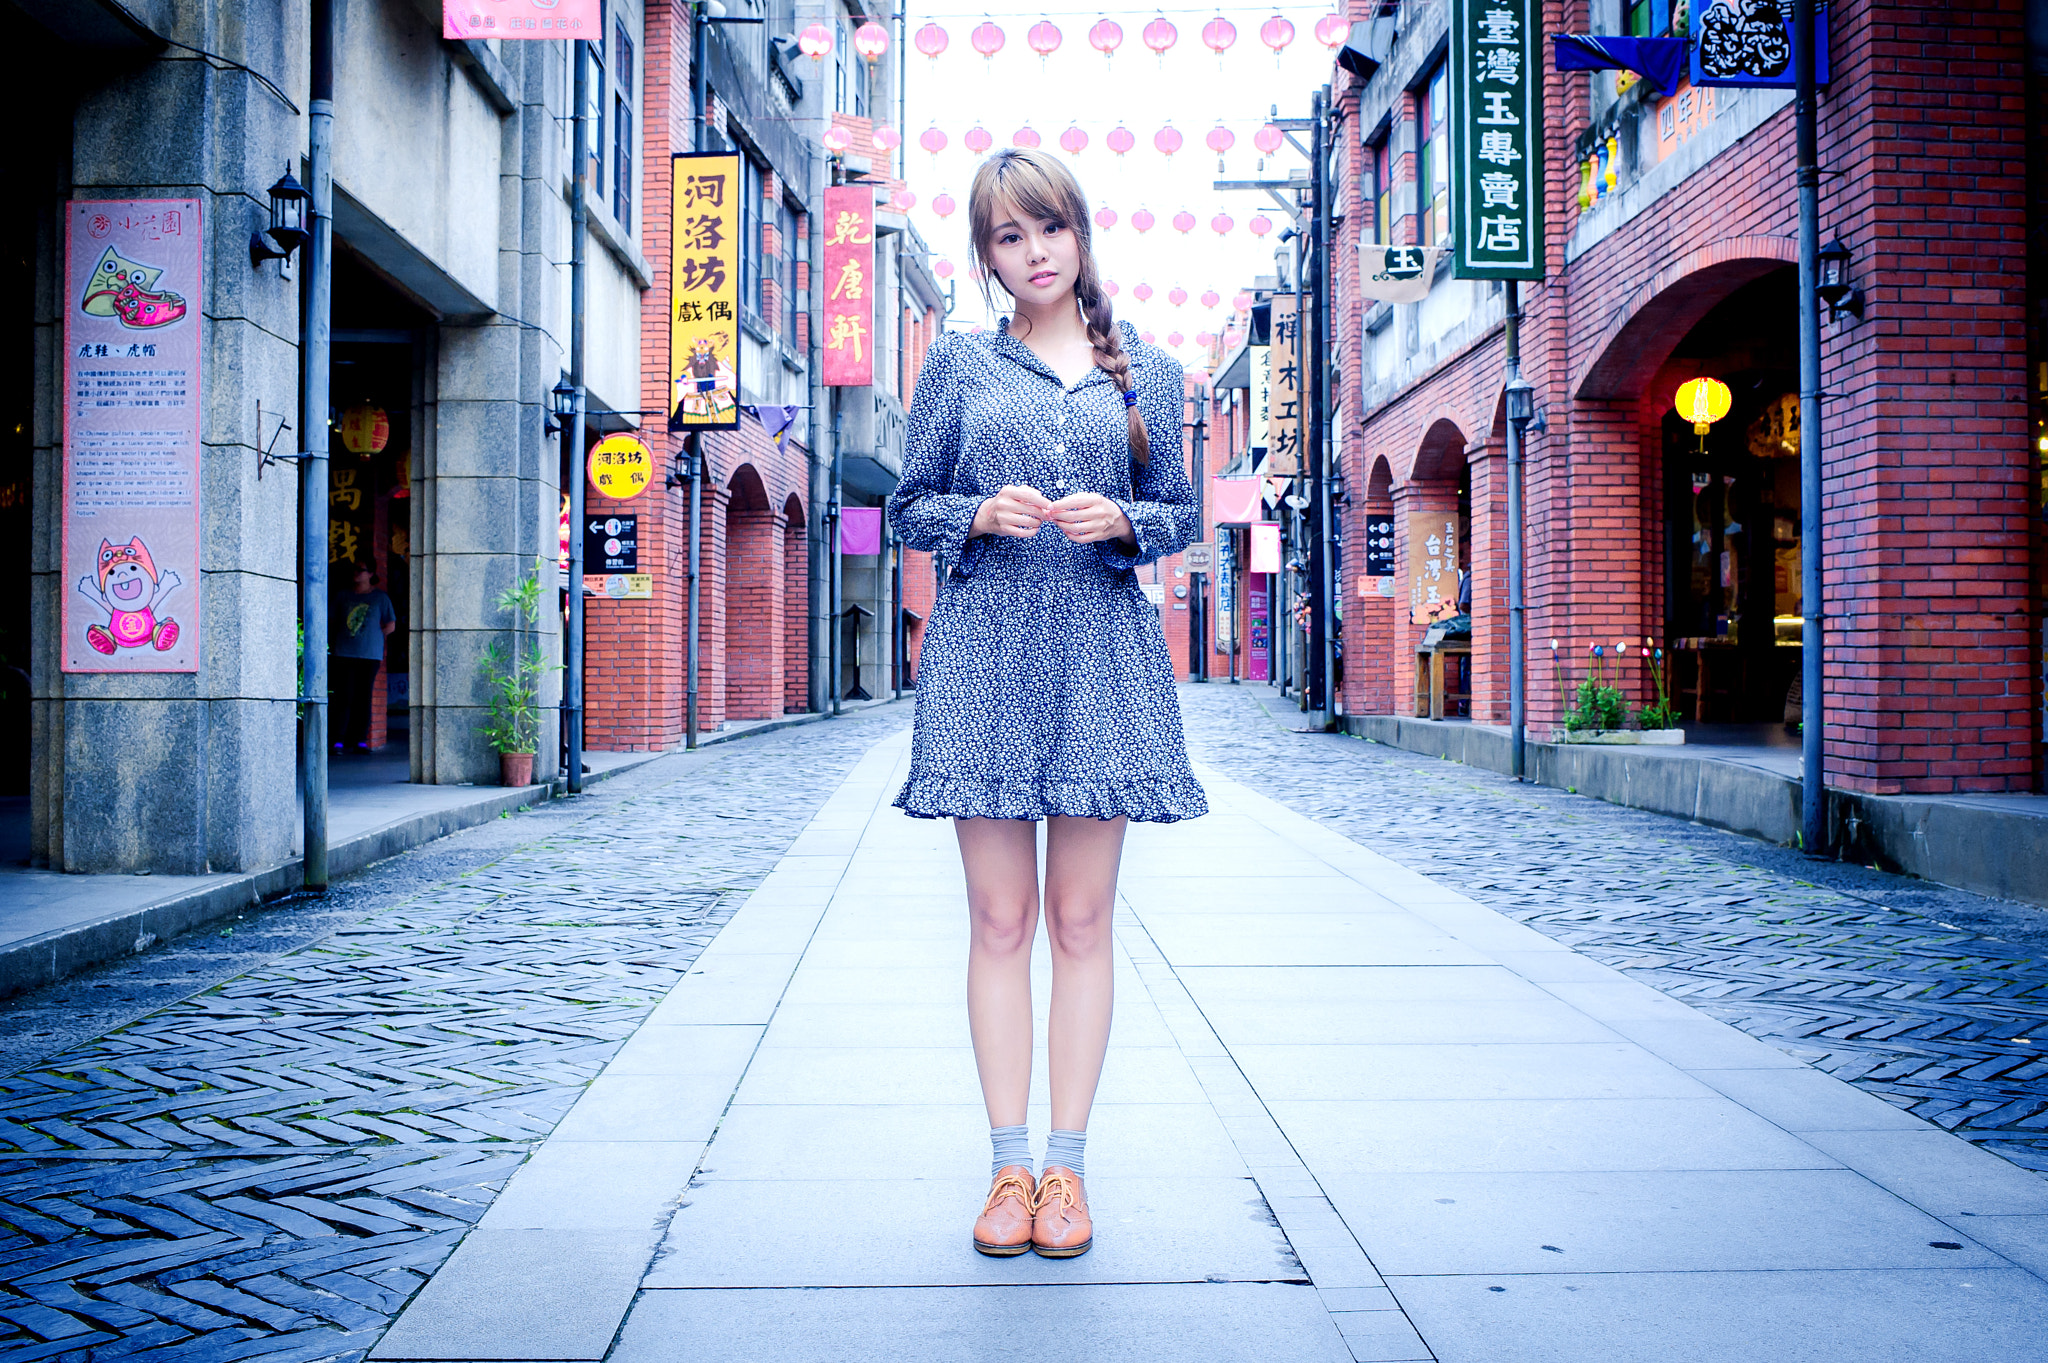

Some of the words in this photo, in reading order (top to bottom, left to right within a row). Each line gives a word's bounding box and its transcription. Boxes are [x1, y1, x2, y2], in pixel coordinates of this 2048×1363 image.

[1476, 8, 1523, 252] 臺灣玉專賣店
[682, 174, 727, 293] 河洛坊
[1387, 246, 1422, 273] 玉
[677, 300, 732, 322] 戲偶
[825, 210, 872, 363] 乾唐軒
[598, 451, 643, 465] 河洛坊
[1424, 533, 1442, 604] 台灣玉
